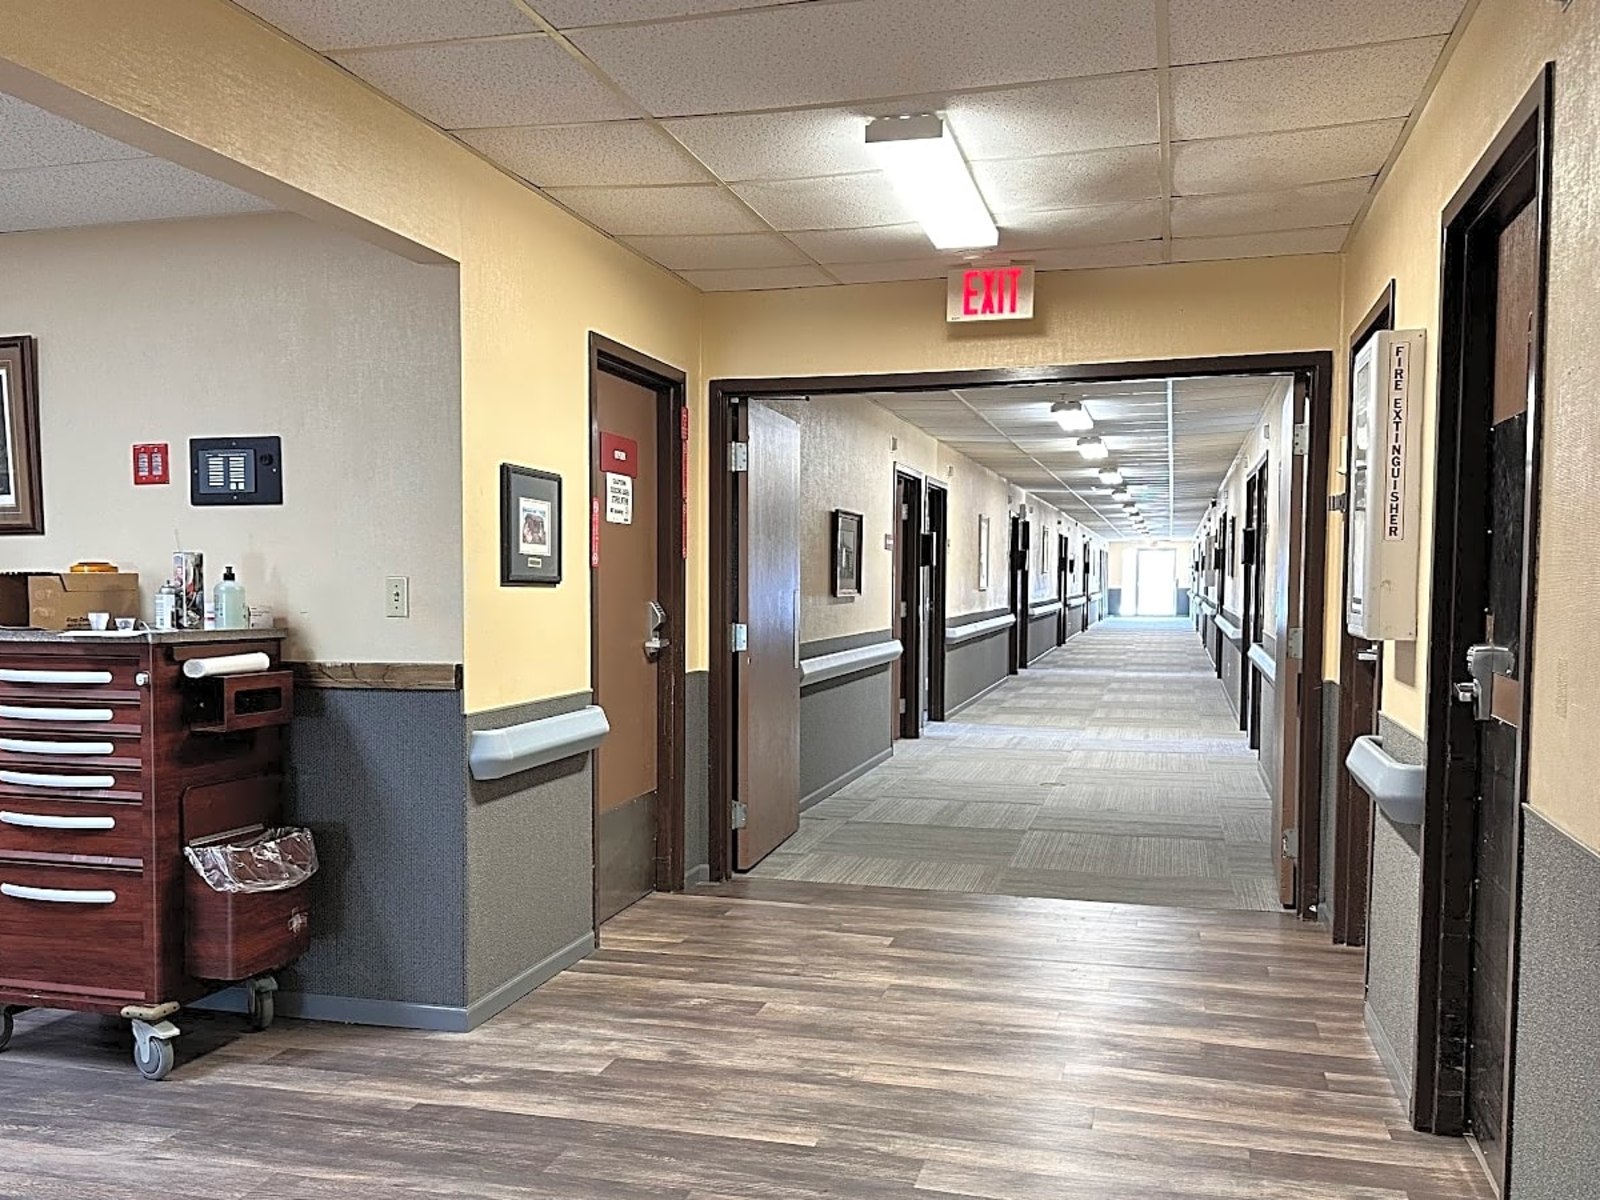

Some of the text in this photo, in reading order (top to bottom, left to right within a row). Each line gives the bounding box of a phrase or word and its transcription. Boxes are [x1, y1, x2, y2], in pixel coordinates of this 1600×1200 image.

[963, 268, 1022, 315] EXIT
[1389, 346, 1405, 537] FIRE EXTINGUISHER
